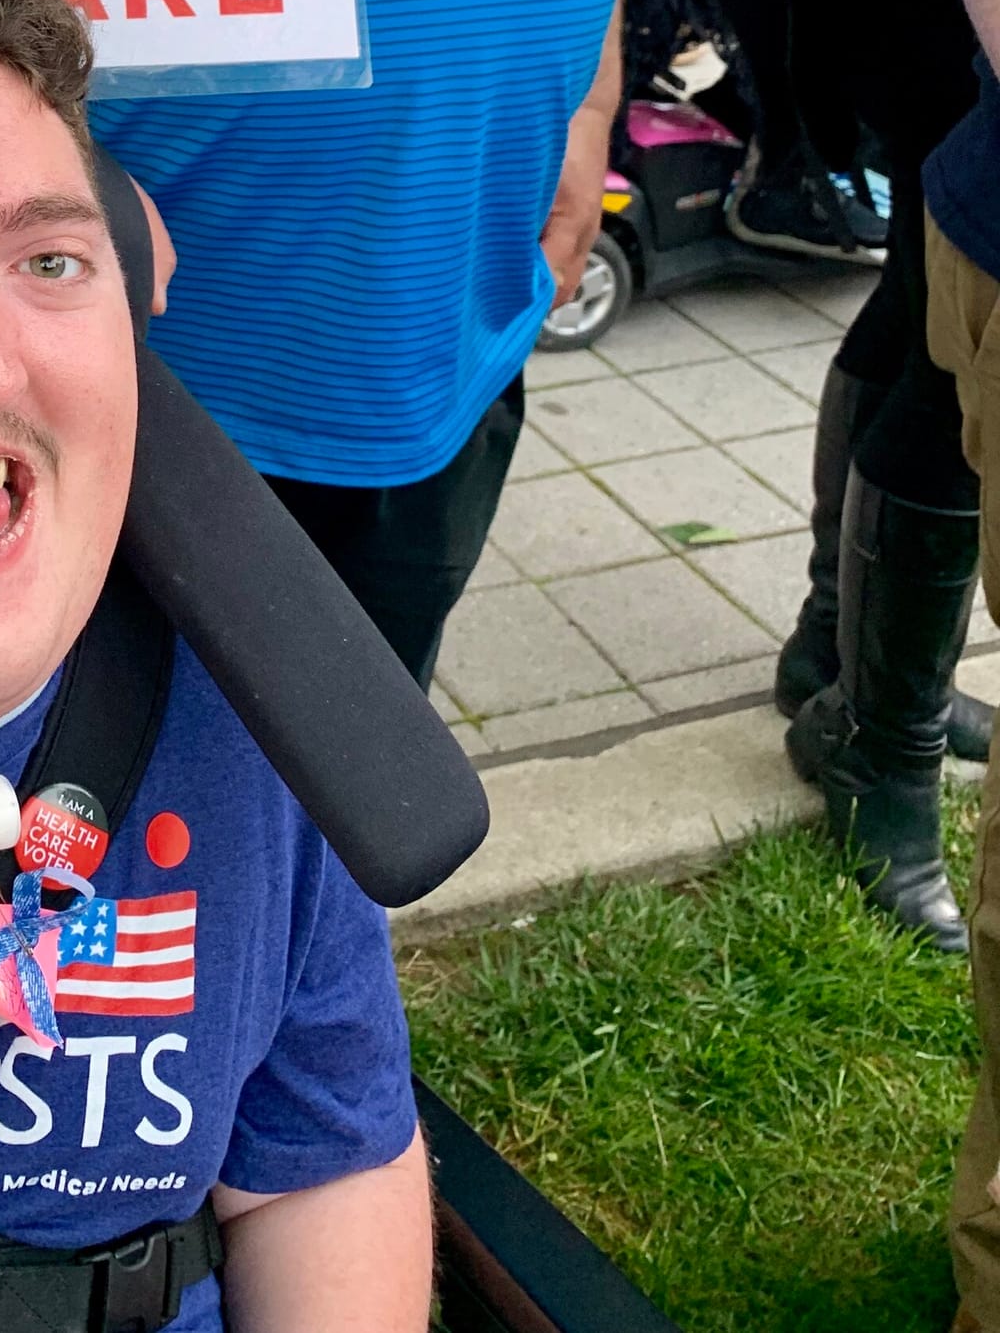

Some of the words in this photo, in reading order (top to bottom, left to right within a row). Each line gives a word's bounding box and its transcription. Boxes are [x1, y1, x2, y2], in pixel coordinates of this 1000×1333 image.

[58, 794, 65, 805] I
[66, 799, 85, 815] AM
[85, 809, 95, 821] A
[29, 825, 72, 857] CARE
[36, 807, 99, 850] HEALTH
[23, 840, 75, 873] VOTER
[111, 1171, 188, 1193] Needs
